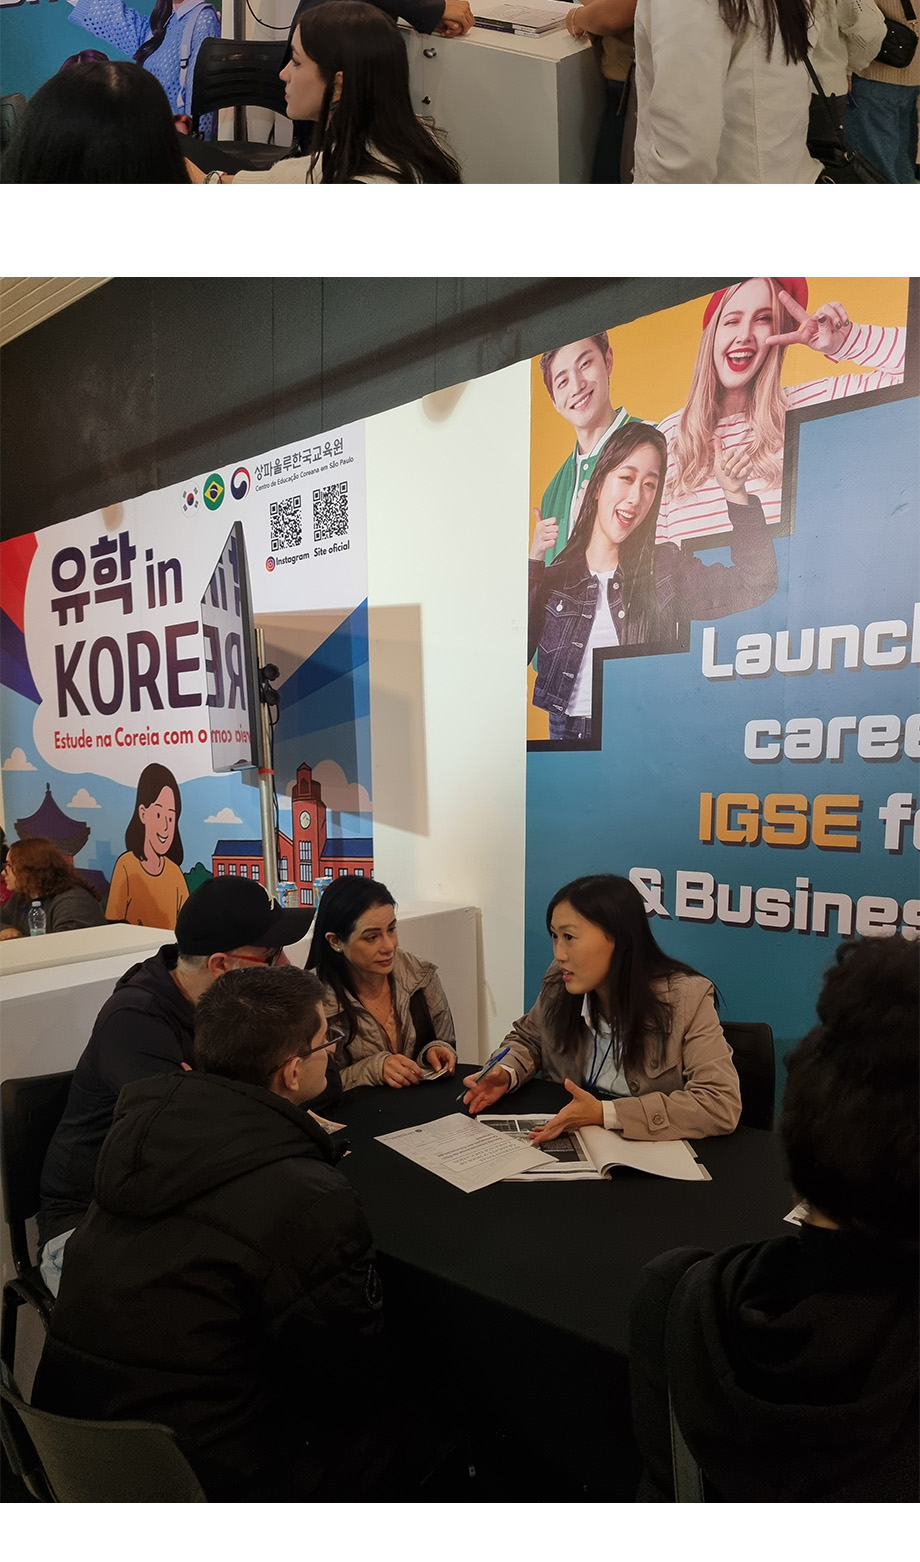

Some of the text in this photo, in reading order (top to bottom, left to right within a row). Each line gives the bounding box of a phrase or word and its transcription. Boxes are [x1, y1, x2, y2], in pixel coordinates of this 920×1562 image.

[254, 437, 344, 481] 상파울루한국교육원
[255, 456, 355, 492] Centro de Educação Coreana em São Paulo
[275, 540, 351, 566] Instagram Site oficial
[51, 531, 137, 627] 유학
[145, 548, 183, 610] in
[54, 725, 209, 750] Estude na Coreia com o
[699, 792, 860, 848] IGSE
